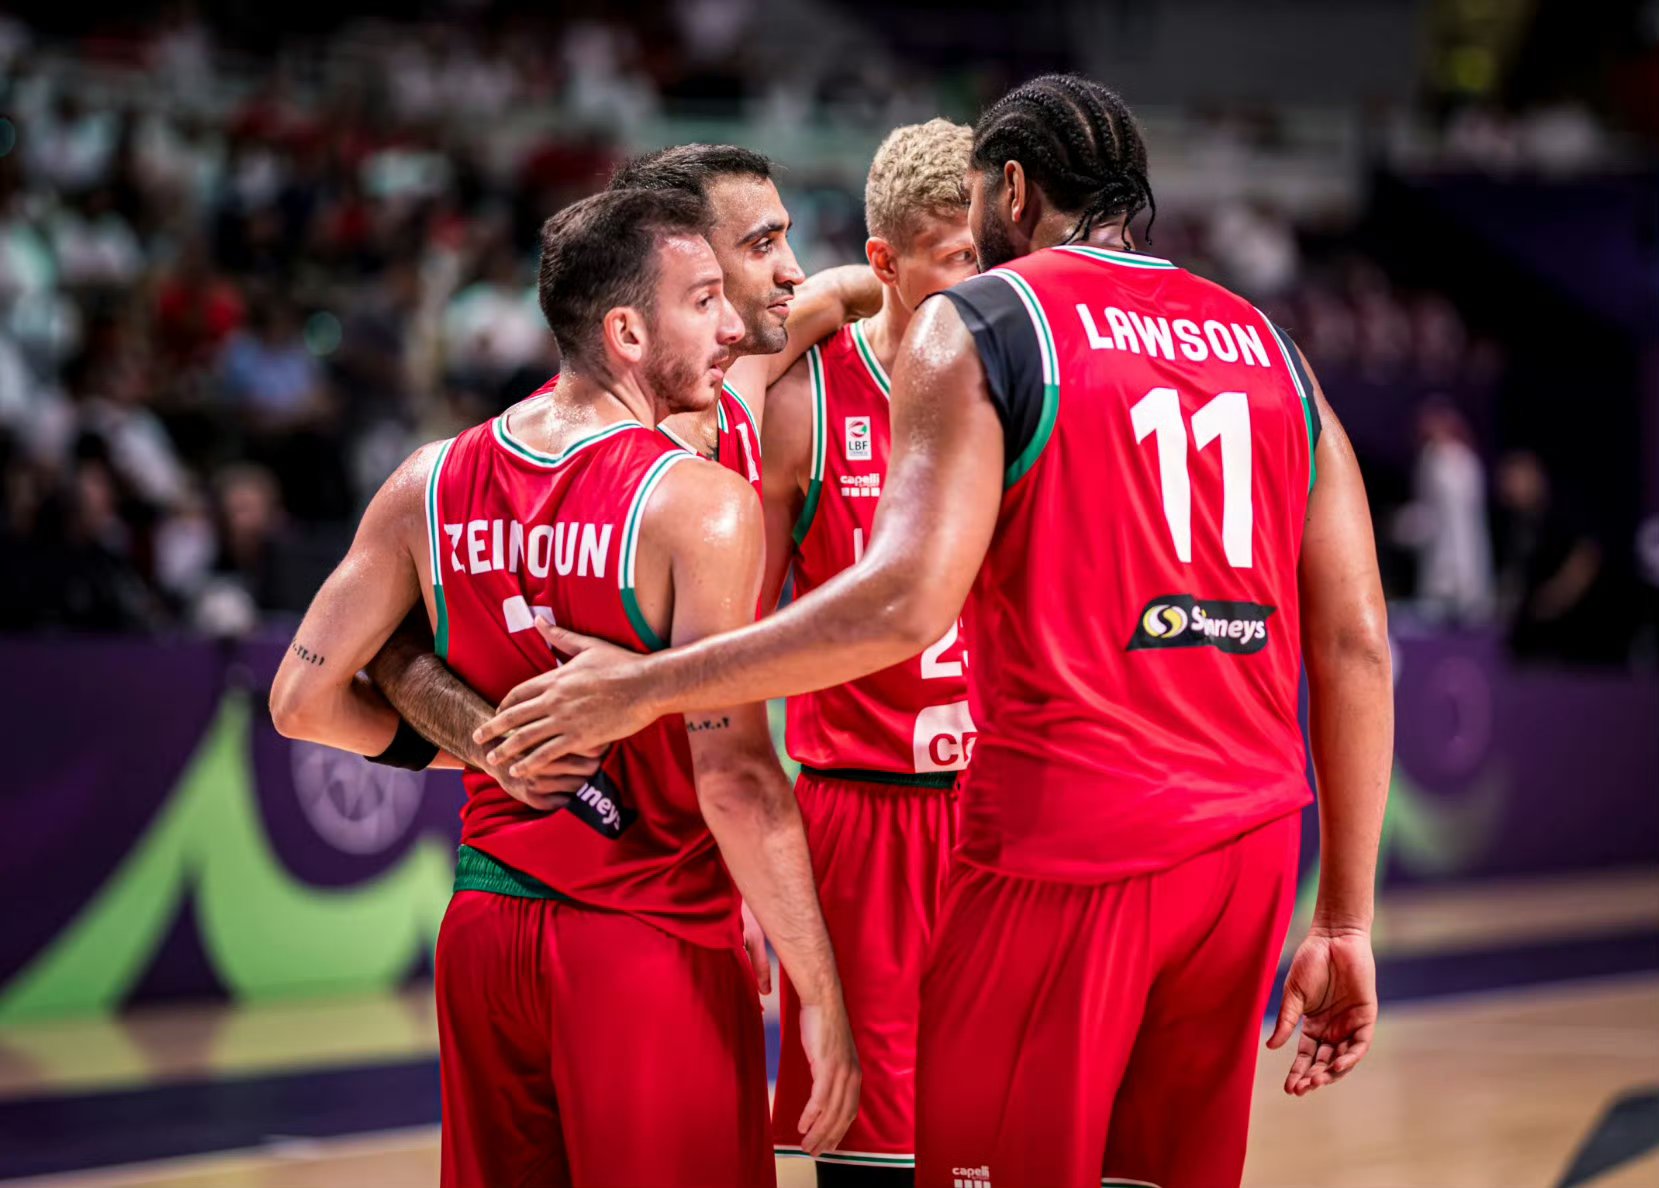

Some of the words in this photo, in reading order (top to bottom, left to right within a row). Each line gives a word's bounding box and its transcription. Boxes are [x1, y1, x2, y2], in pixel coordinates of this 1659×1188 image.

[1075, 303, 1271, 368] LAWSON
[848, 440, 869, 451] LBF
[840, 473, 880, 487] capelli
[1130, 387, 1253, 569] 11
[443, 518, 613, 578] ZEINOUN
